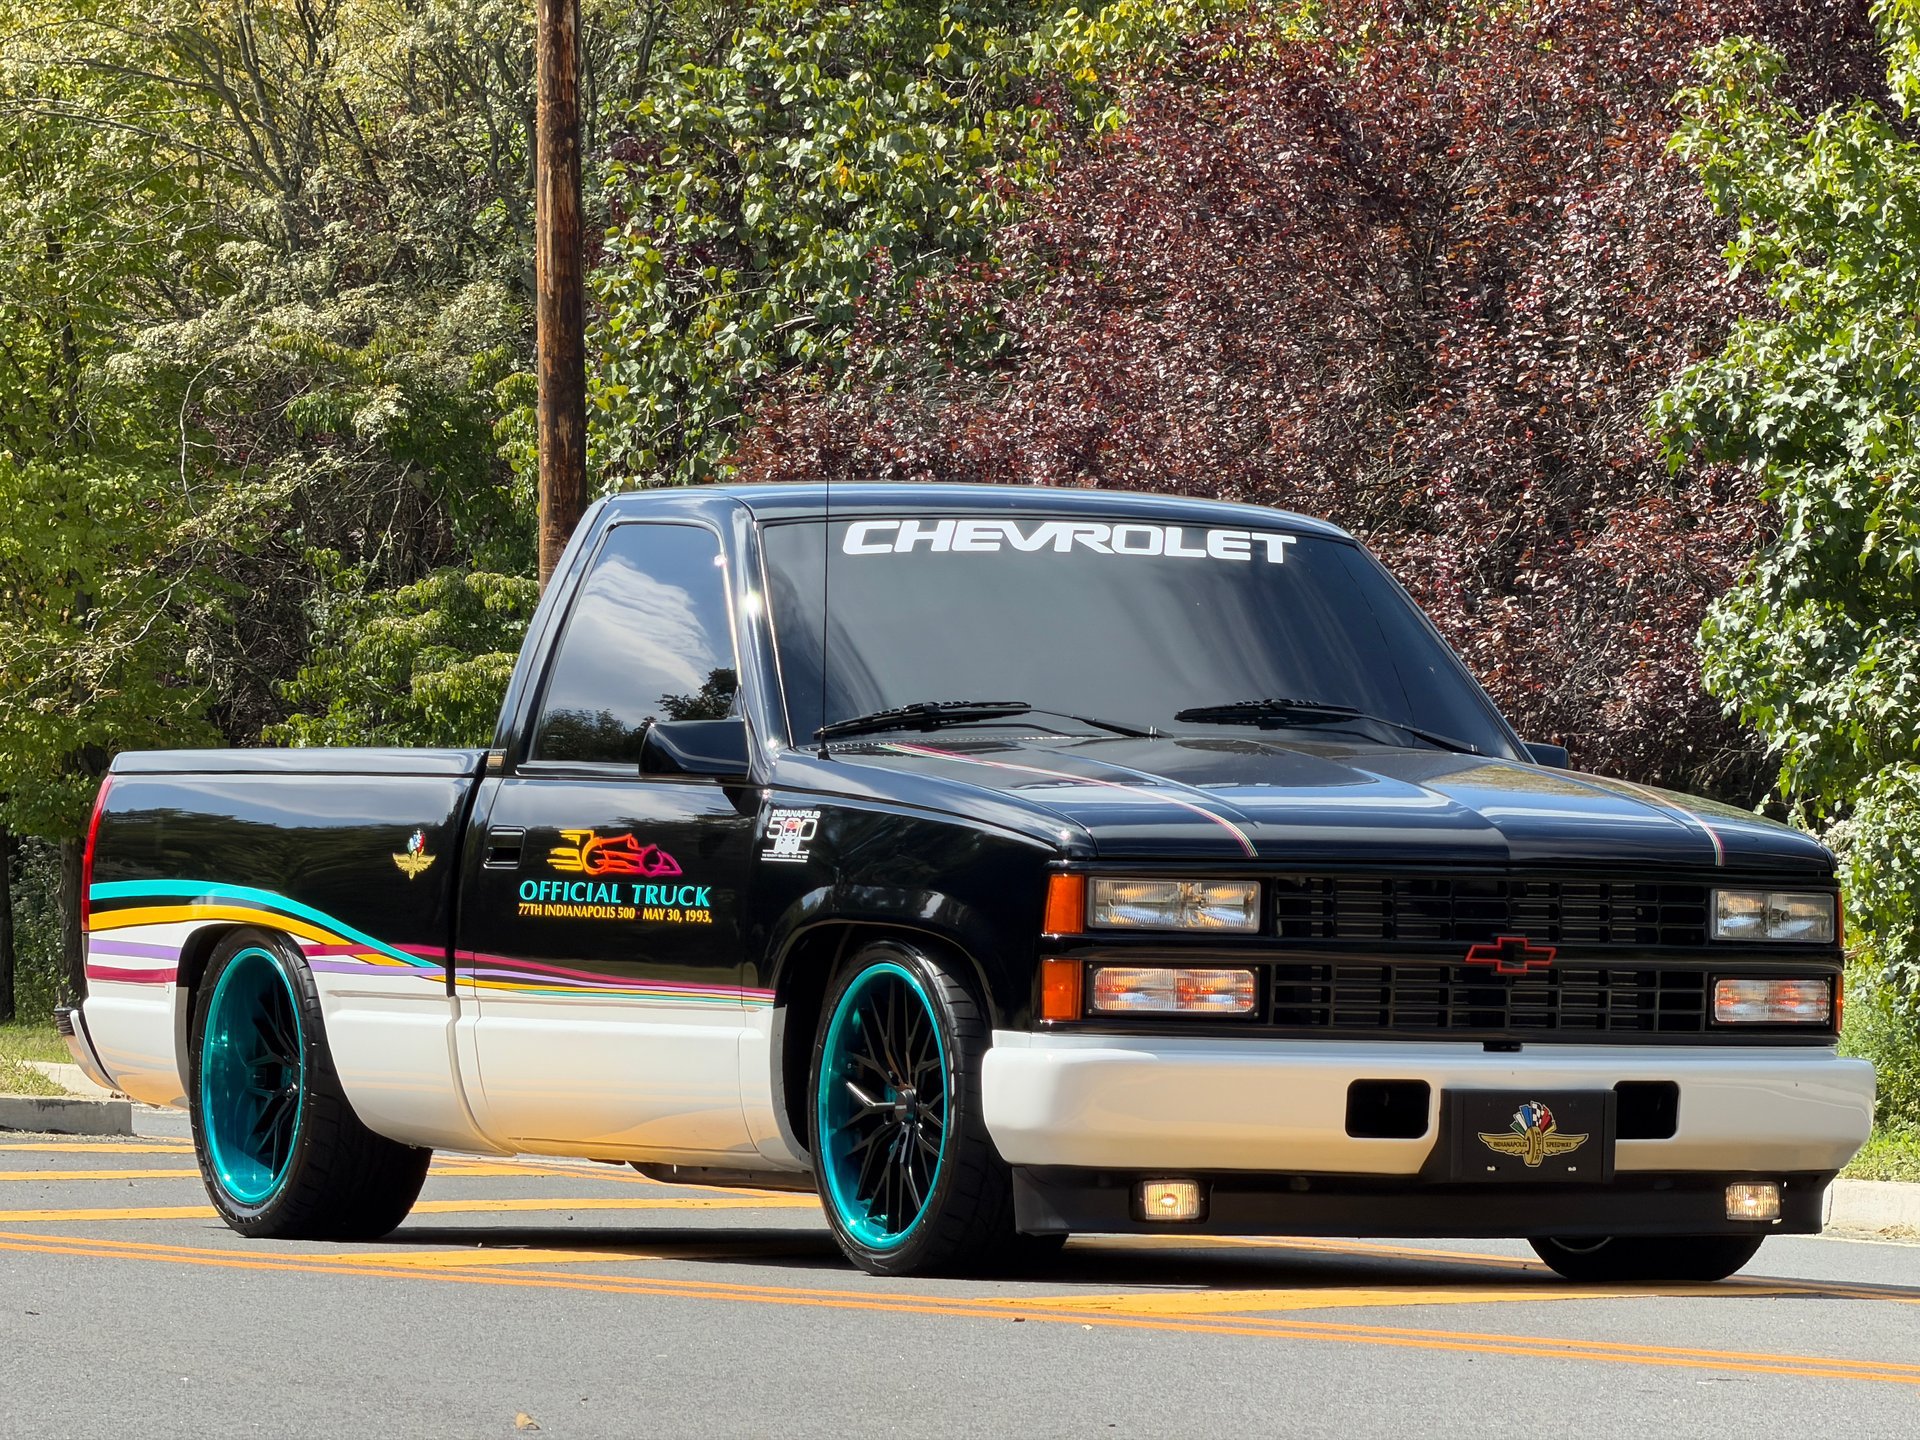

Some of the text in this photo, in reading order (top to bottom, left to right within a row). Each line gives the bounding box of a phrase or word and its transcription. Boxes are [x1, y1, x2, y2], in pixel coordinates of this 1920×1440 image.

[842, 519, 1297, 564] CHEVROLET
[772, 810, 821, 819] INDIANAPOLIS
[767, 817, 818, 841] 500
[519, 880, 712, 907] OFFICIAL TRUCK
[518, 903, 542, 916] 77TH
[545, 904, 616, 917] INDIANAPOLIS
[617, 907, 636, 919] 500
[643, 908, 666, 920] MAY
[667, 908, 683, 923] 30,
[1534, 1131, 1542, 1161] MOTOR
